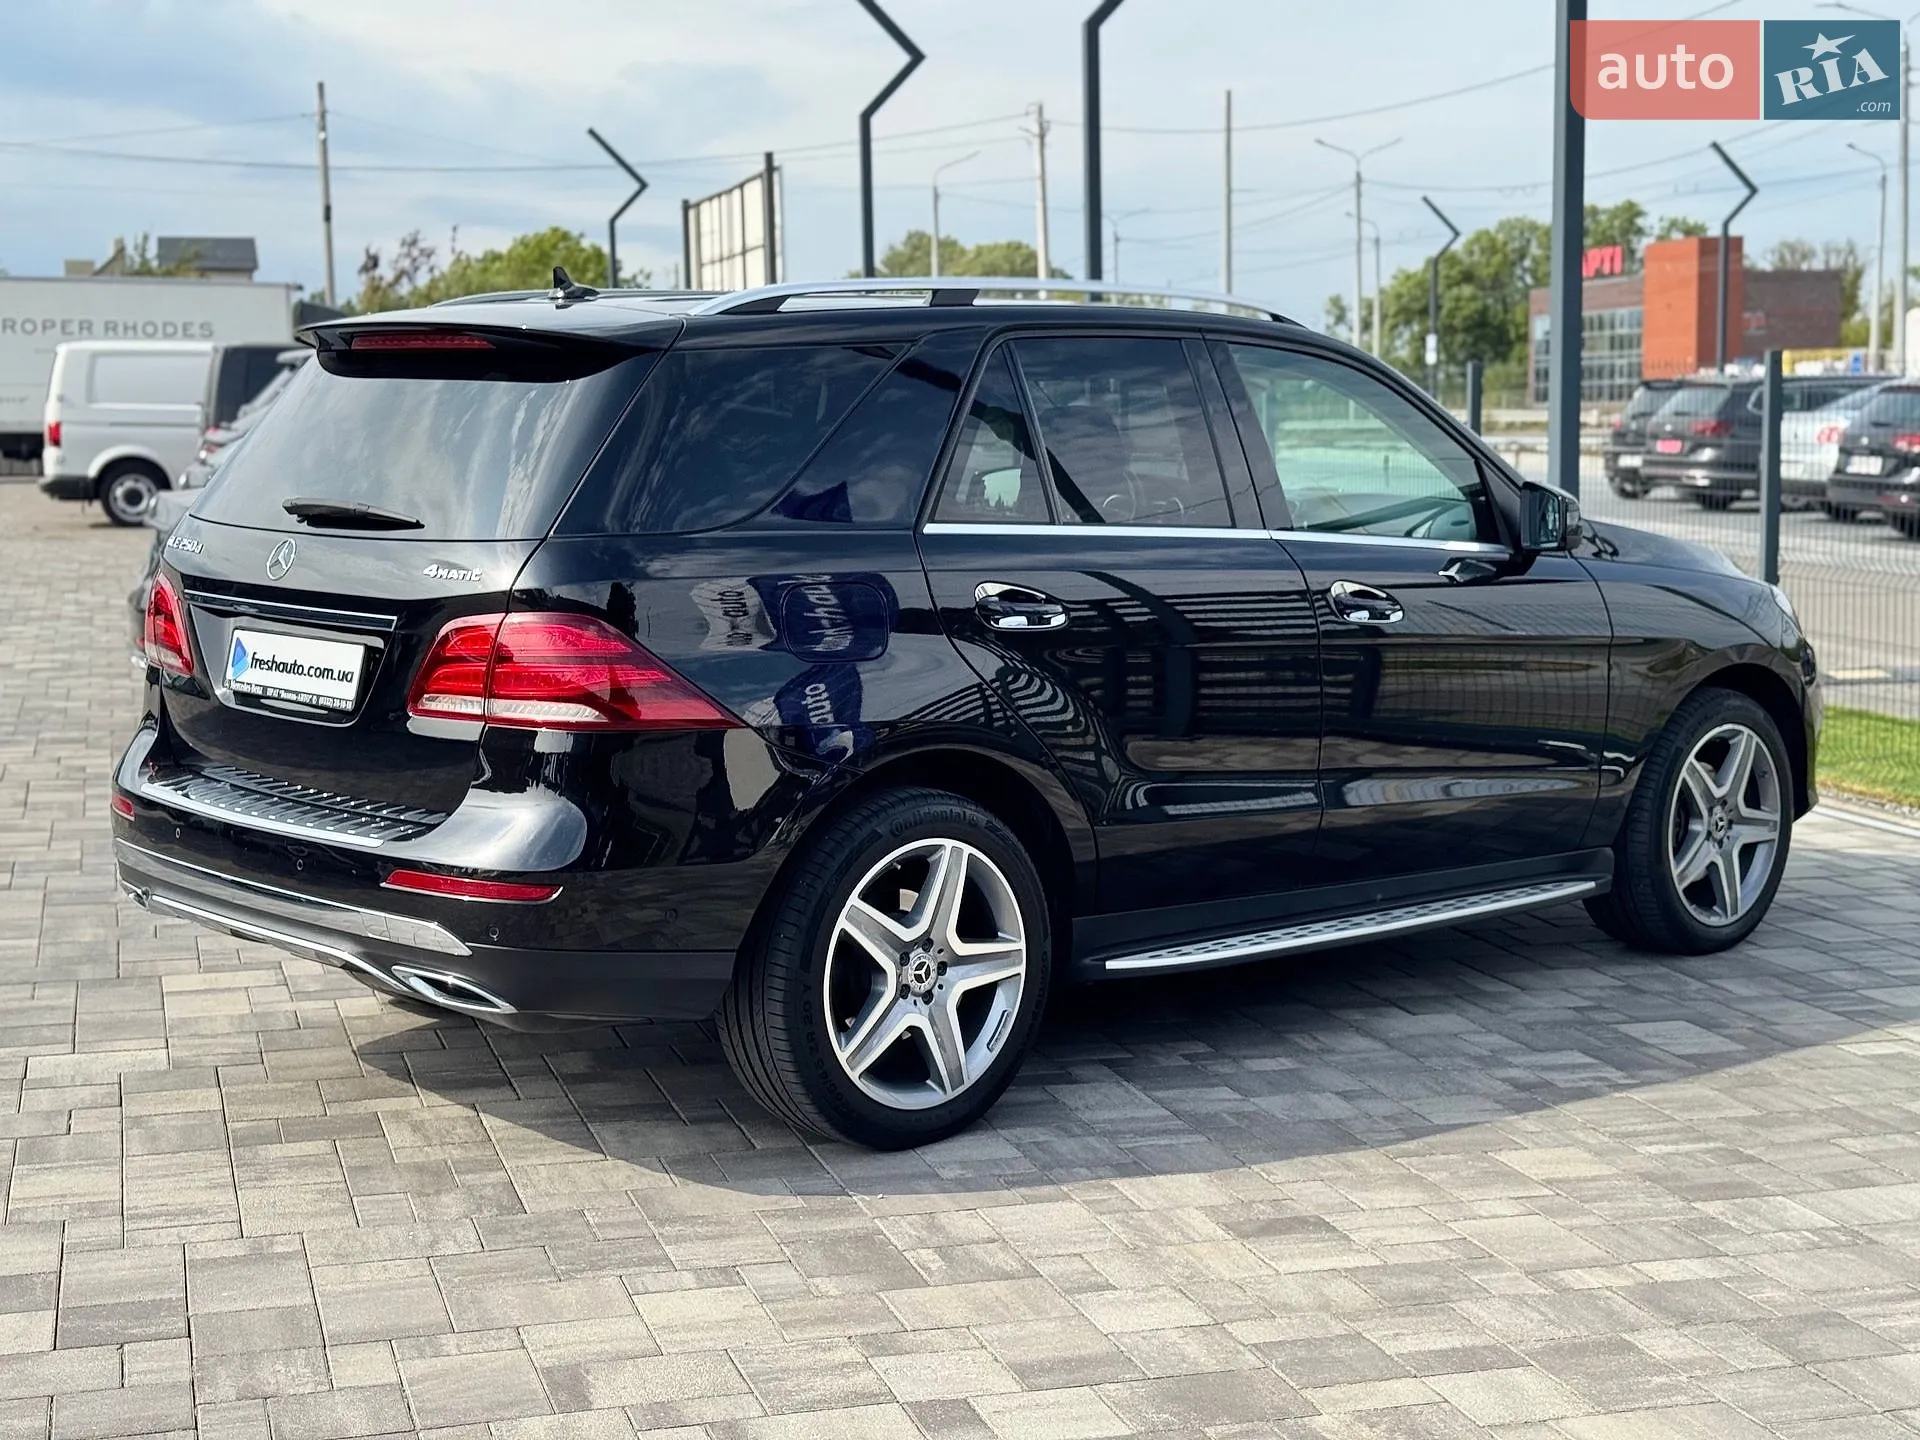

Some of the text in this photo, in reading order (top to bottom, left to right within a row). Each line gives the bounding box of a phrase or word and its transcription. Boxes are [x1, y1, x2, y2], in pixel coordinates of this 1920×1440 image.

[1, 318, 215, 338] ROPER RHODES
[422, 564, 482, 582] 4MATIC
[250, 651, 355, 683] freshauto.com.ua
